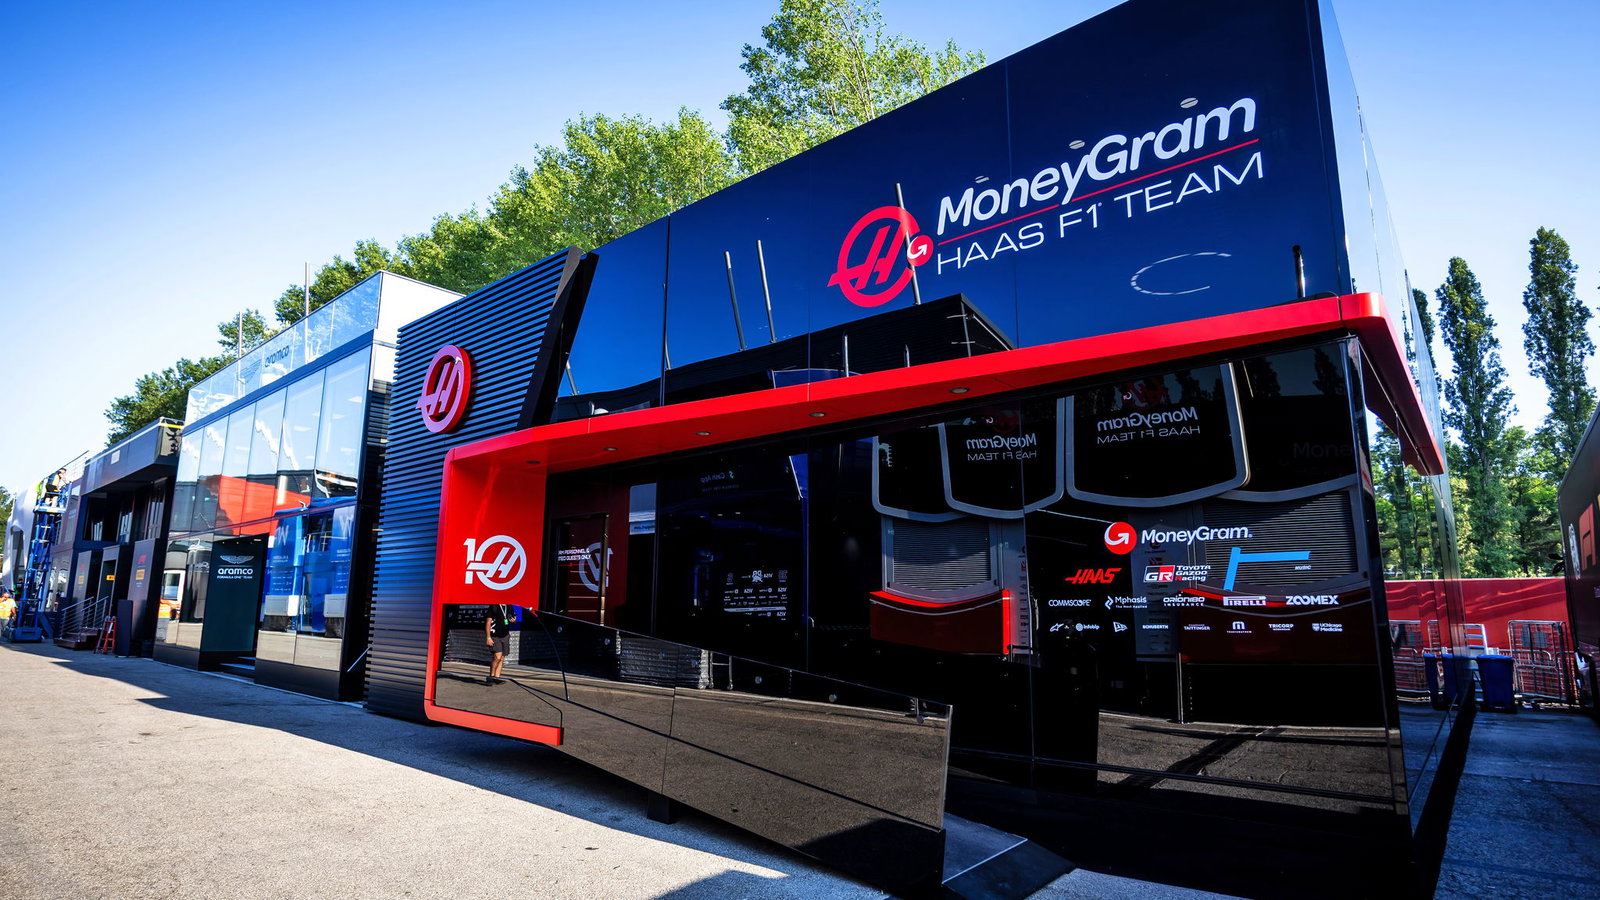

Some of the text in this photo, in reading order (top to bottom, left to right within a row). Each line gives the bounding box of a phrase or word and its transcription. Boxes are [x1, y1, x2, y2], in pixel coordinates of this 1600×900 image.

[936, 97, 1257, 236] MoneyGram
[937, 151, 1264, 275] HAAS F1 TEAM
[264, 345, 290, 368] aramco
[1065, 567, 1122, 585] HAAS
[1048, 599, 1091, 607] COMMSCOPE
[1114, 596, 1147, 605] Mphasis
[1223, 595, 1267, 606] PIRELLI
[1285, 594, 1339, 606] ZOOMEX
